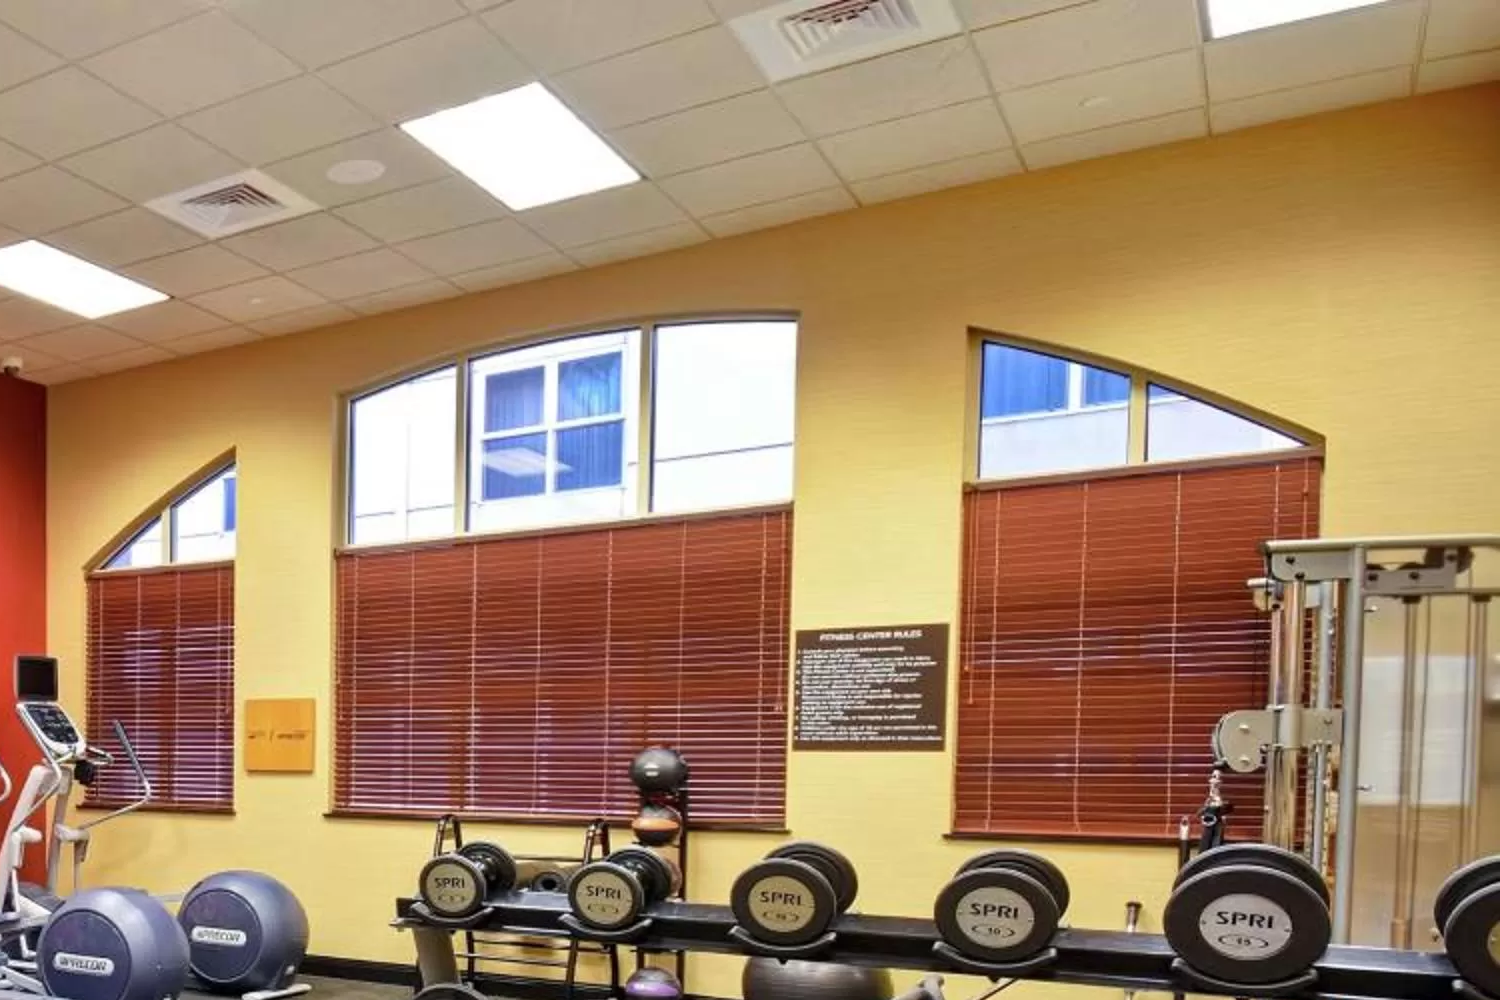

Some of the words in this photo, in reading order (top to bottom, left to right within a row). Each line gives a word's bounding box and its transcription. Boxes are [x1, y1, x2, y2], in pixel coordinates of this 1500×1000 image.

[856, 631, 892, 640] CENTER
[893, 629, 923, 639] RULES
[435, 877, 465, 889] SPRI
[586, 886, 620, 900] SPRI
[760, 891, 802, 906] SPRI
[970, 903, 1018, 920] SPRI
[1216, 911, 1274, 929] SPRI
